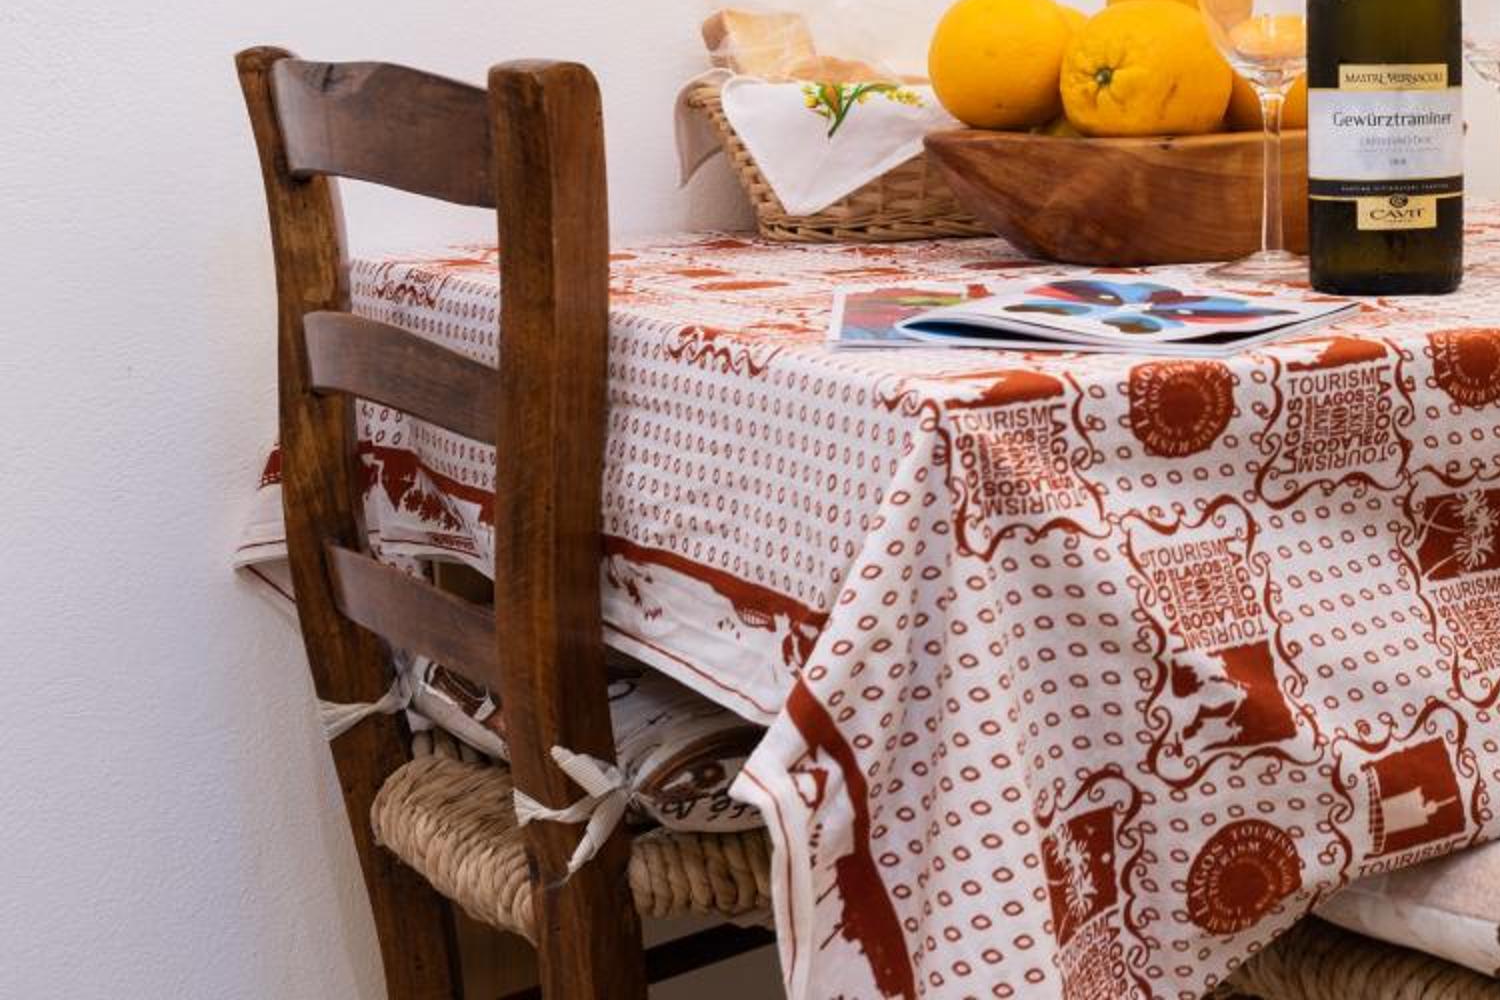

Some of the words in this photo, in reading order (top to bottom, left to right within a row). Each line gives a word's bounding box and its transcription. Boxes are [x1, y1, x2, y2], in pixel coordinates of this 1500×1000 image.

[1333, 110, 1452, 128] Gewürztraminer
[1370, 207, 1424, 220] CAVIT
[1288, 368, 1376, 396] TOURISM
[1314, 389, 1365, 408] LAGOS
[1374, 365, 1393, 446] LAGOS
[949, 405, 1048, 433] TOURISM
[1297, 446, 1389, 474] TOURISM
[1149, 538, 1227, 569] TOURISM
[1430, 577, 1500, 603] TOURISM
[1185, 617, 1268, 650] TOURISM
